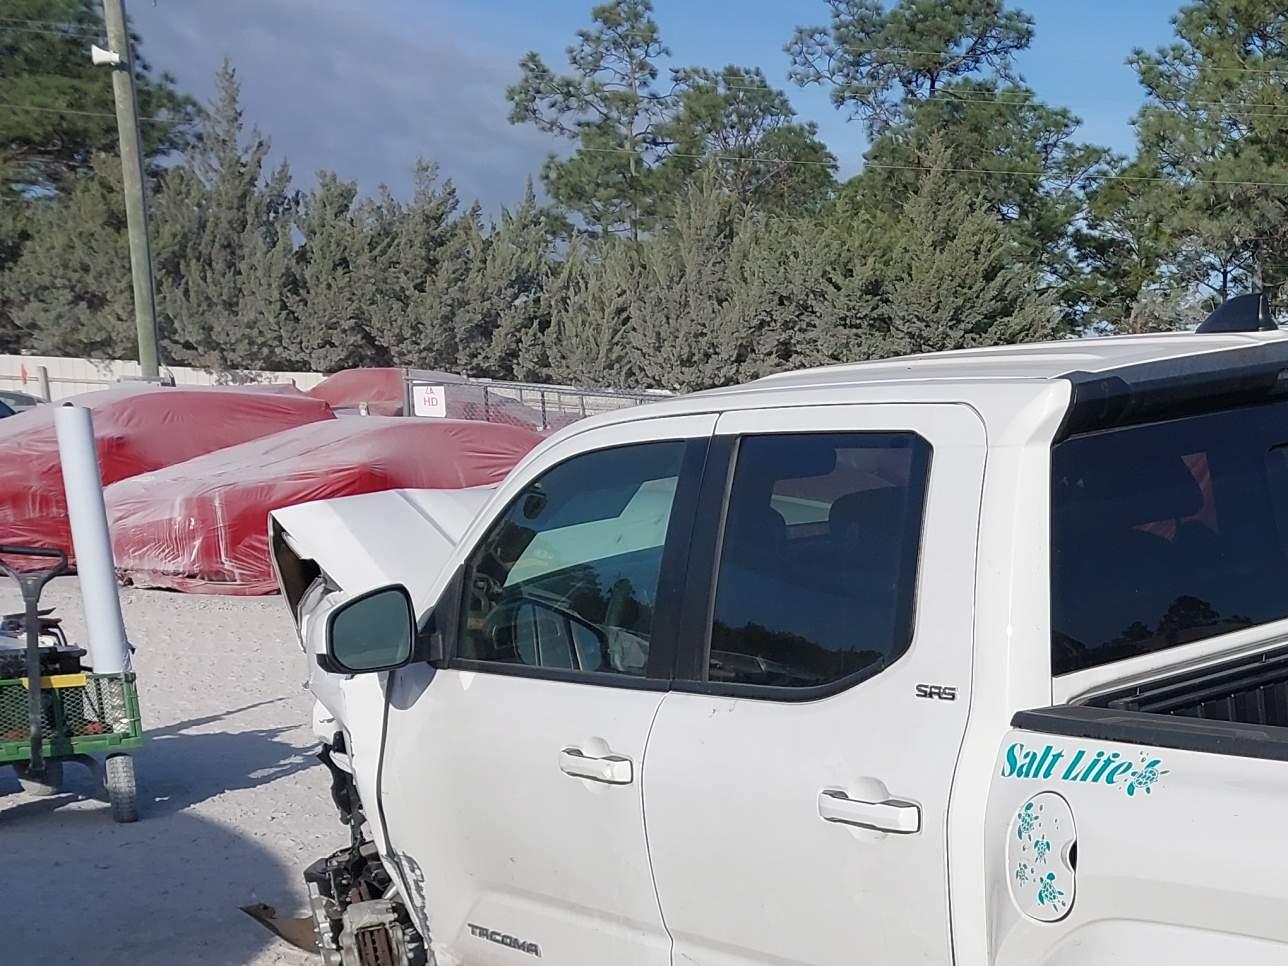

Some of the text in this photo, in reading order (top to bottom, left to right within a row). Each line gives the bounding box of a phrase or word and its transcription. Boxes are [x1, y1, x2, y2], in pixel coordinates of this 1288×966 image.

[423, 396, 439, 407] HD
[1001, 742, 1133, 785] Salt Life
[467, 922, 542, 958] TACOMA
